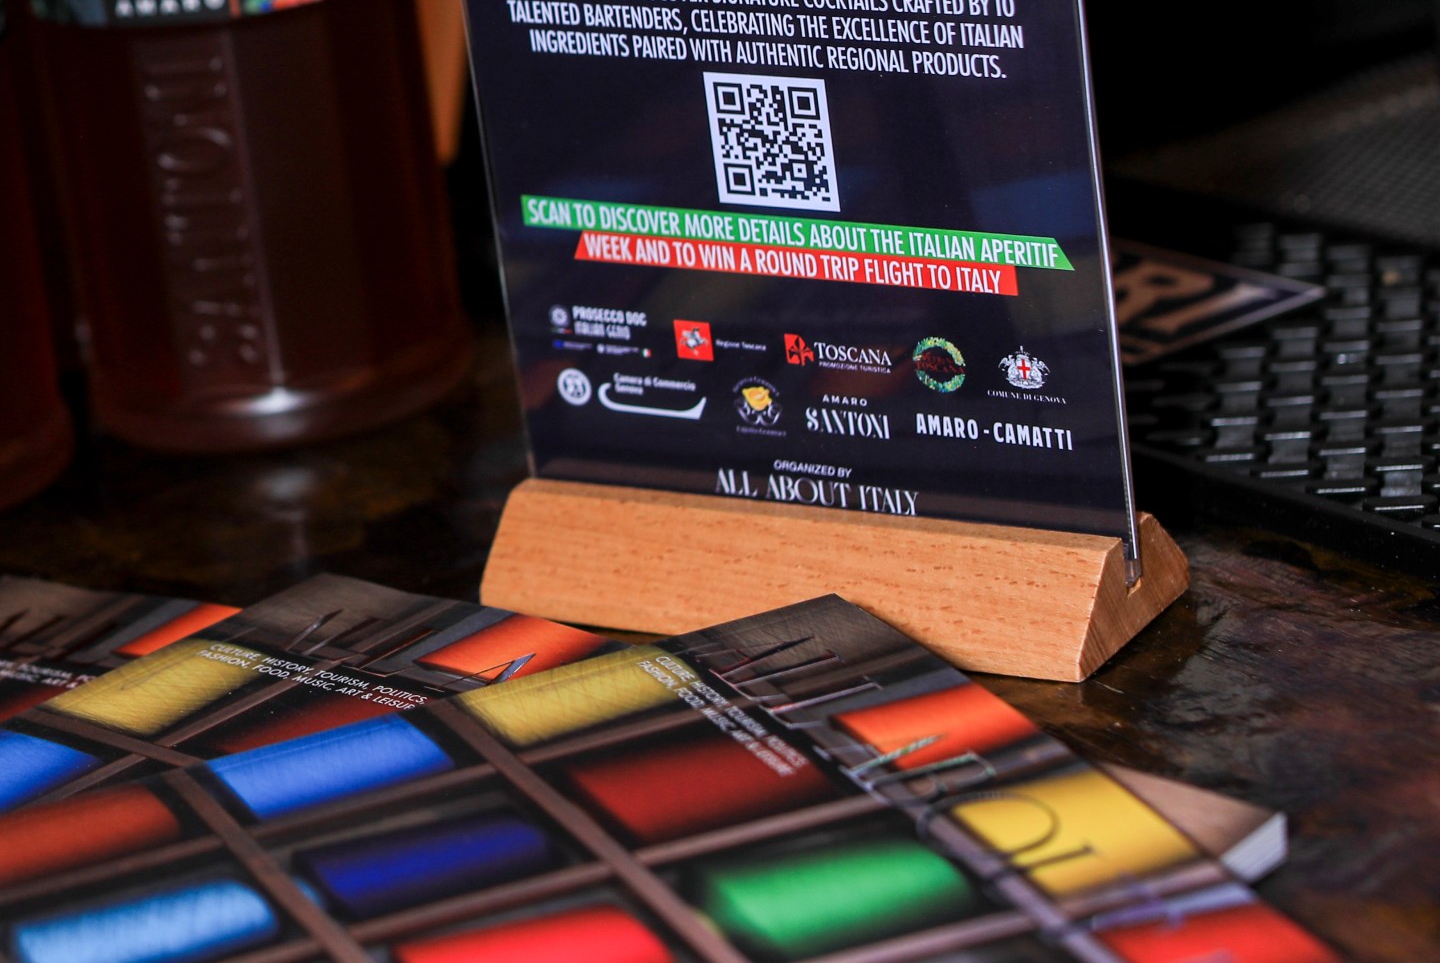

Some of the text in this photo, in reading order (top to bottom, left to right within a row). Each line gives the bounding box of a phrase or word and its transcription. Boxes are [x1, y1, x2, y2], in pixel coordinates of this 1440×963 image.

[507, 0, 1024, 49] TALENTED BARTENDERS, CELEBRATING THE EXCELLENCE OF ITALIAN
[529, 28, 1007, 79] INGREDIENTS PAIRED WITH AUTHENTIC REGIONAL PRODUCTS.
[527, 198, 1059, 268] SCAN TO DISCOVER MORE DETAILS ABOUT THE ITALIAN APERITIF
[583, 232, 1001, 294] WEEK AND TO WIN A ROUND TRIP FLIGHT TO ITALY
[572, 305, 648, 327] PROSECCO DOC
[814, 341, 892, 366] TOSCANA
[819, 360, 892, 375] PROMOZIONE TURISTICA
[822, 393, 868, 407] AMARO
[987, 388, 1067, 406] COMUNE DI GENOVA
[805, 407, 891, 440] SANTONI
[916, 412, 979, 440] AMARO
[993, 421, 1073, 451] CAMATTI
[773, 459, 852, 479] ORGANIZED BY
[715, 467, 919, 517] ALL ABOUT ITALY
[196, 649, 251, 669] FASHION,
[252, 664, 291, 680] FOOD,
[292, 674, 333, 691] MUSIC,
[335, 686, 363, 697] ART
[361, 692, 374, 701] &
[261, 656, 314, 675] HISTORY,
[315, 669, 371, 690] TOURISM,
[372, 685, 429, 705] POLITICS,
